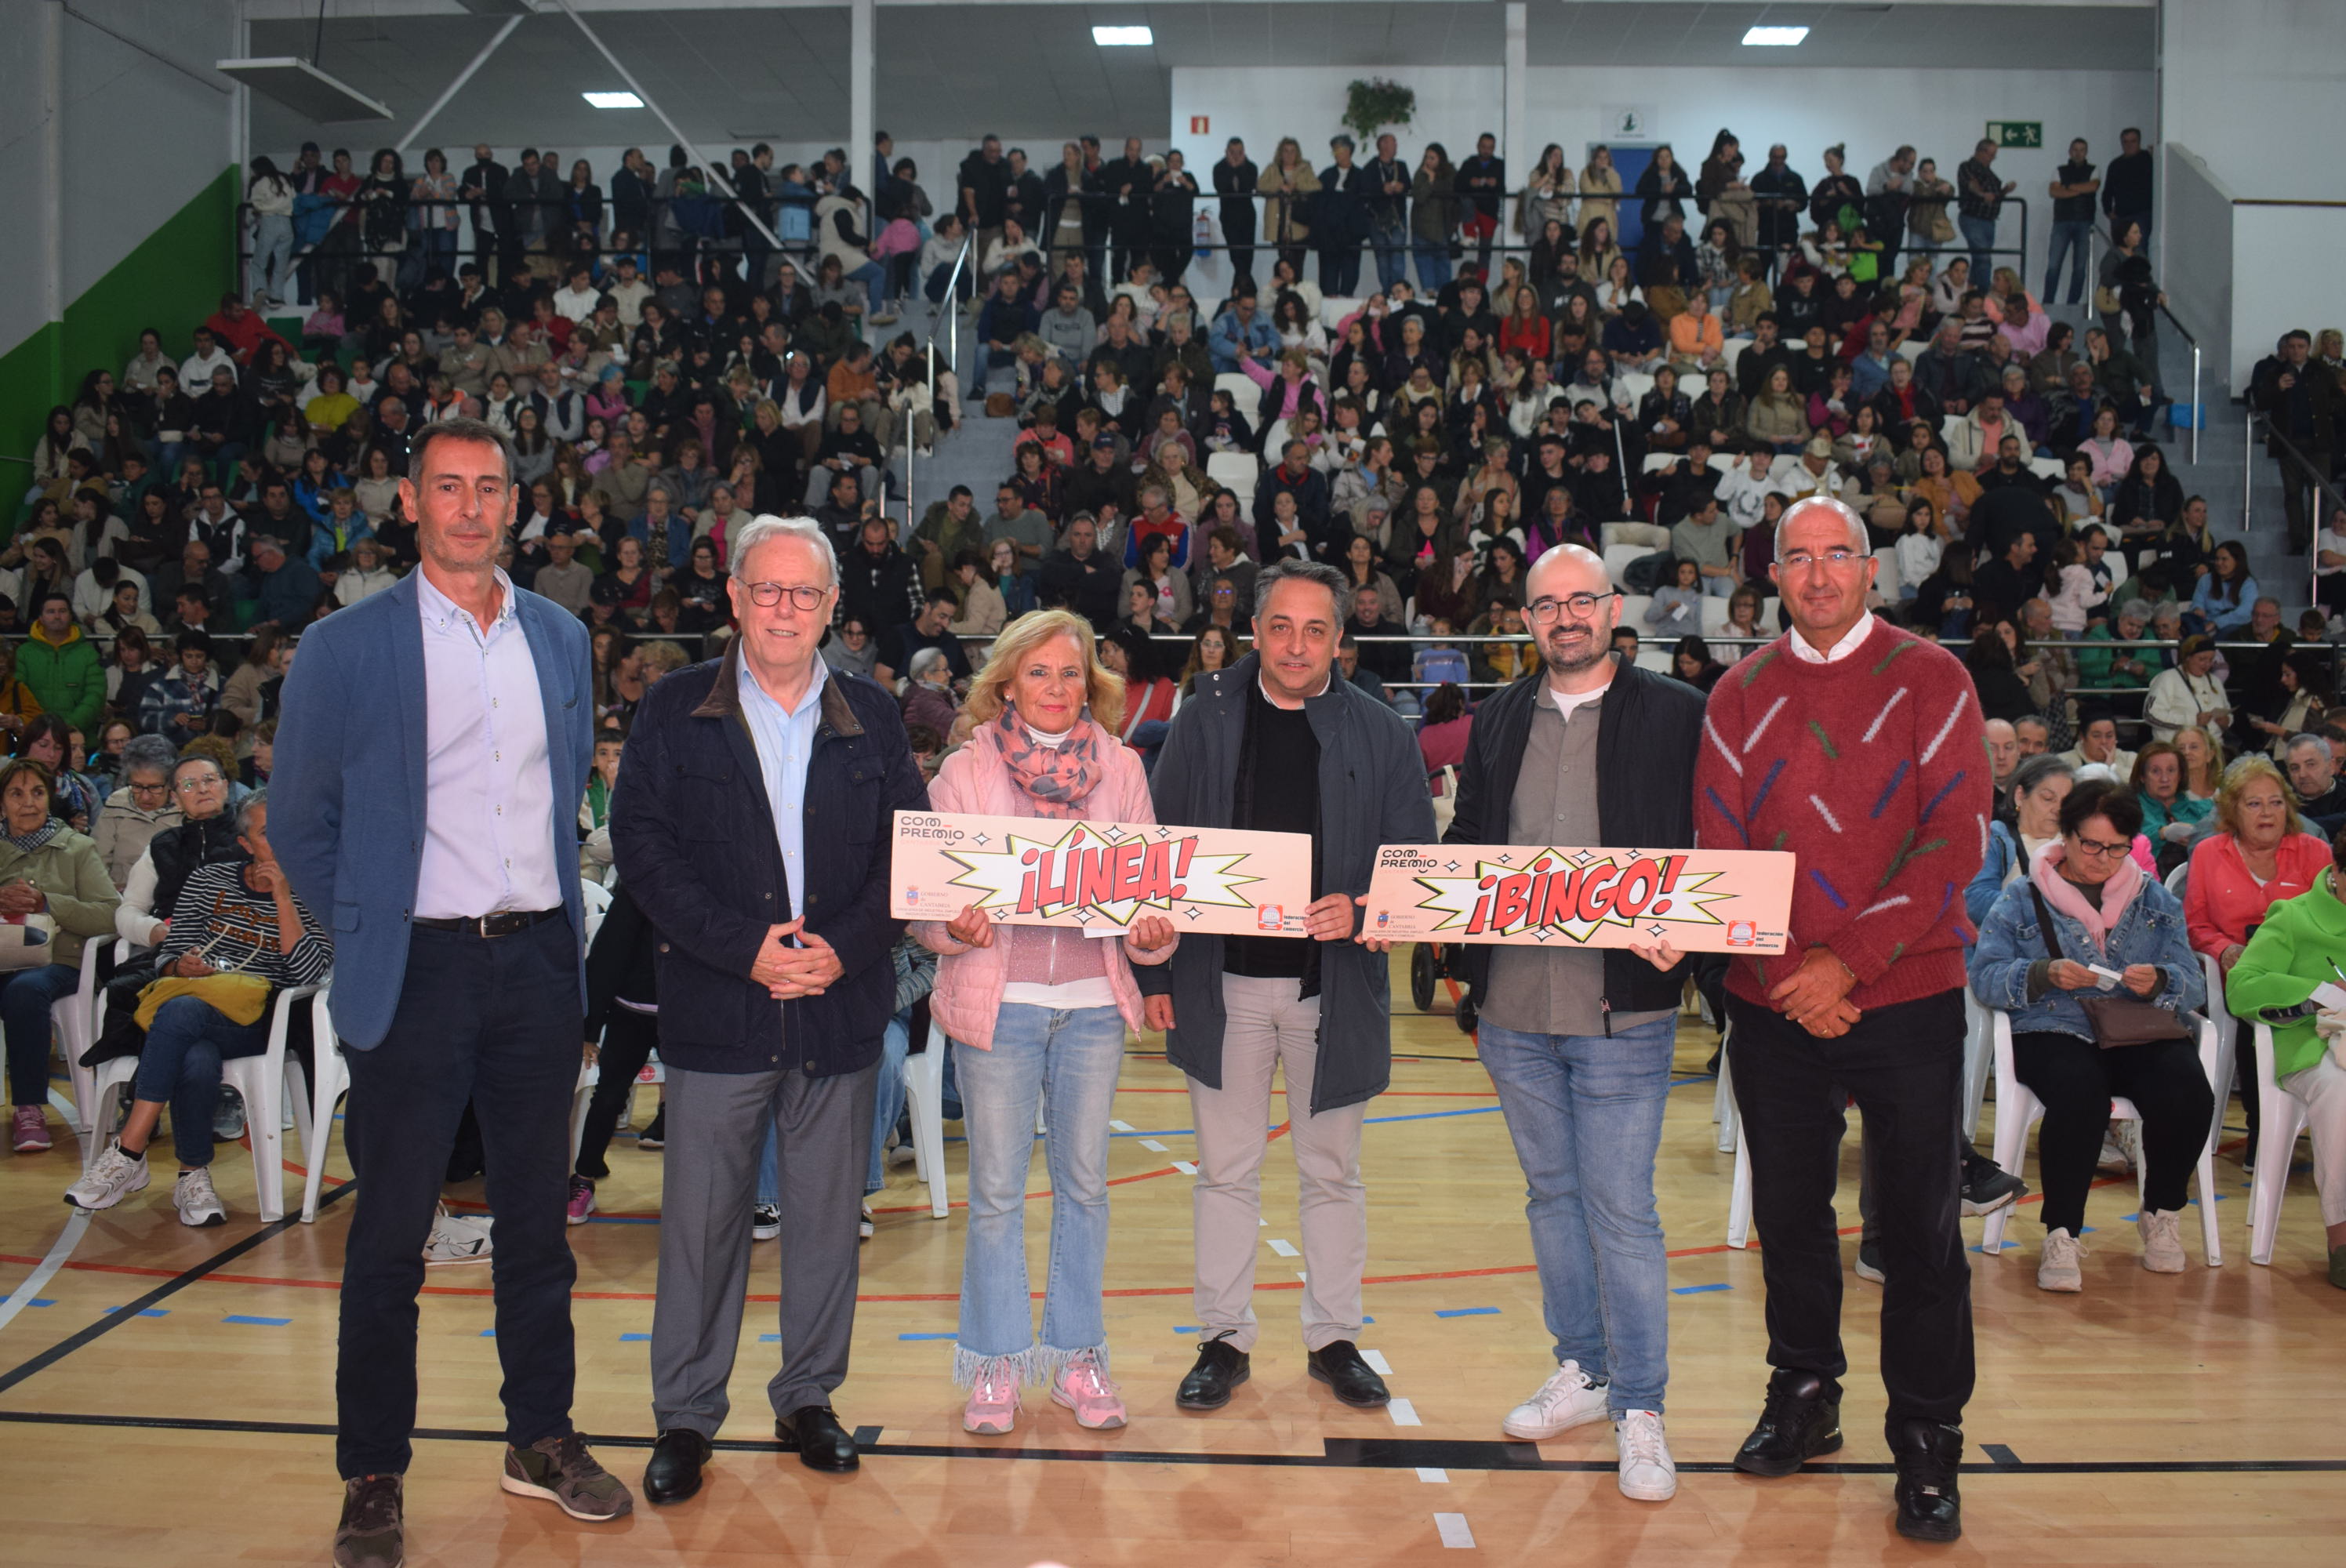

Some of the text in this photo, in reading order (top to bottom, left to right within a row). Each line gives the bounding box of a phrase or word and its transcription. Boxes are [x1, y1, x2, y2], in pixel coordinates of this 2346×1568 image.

[900, 827, 965, 840] PREMIO
[1380, 858, 1438, 868] PREMIO
[1016, 828, 1199, 914] ¡LÍNEA!
